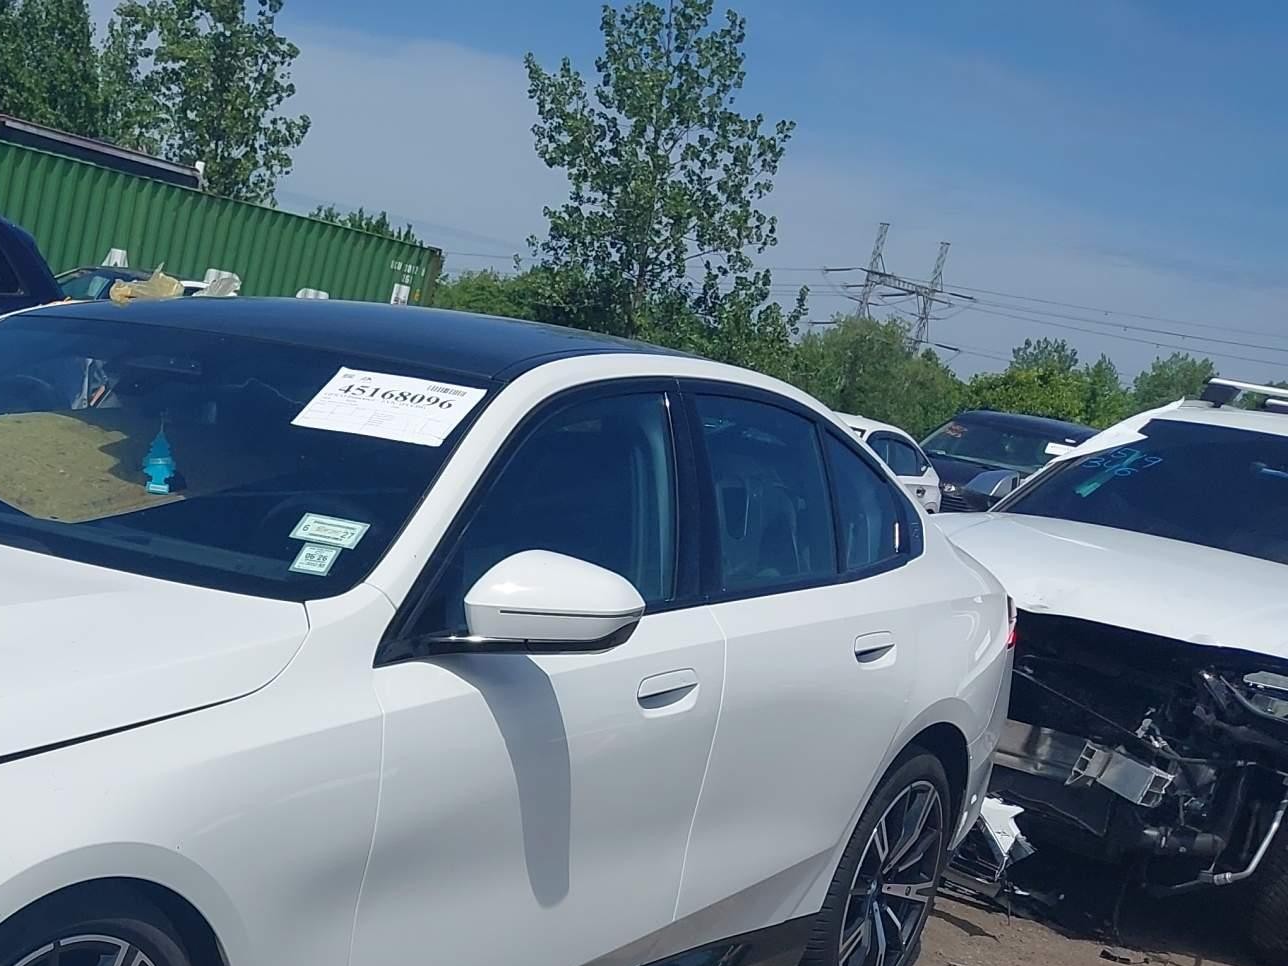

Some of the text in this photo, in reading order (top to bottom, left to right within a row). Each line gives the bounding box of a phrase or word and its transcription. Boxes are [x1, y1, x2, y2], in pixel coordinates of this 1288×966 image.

[338, 383, 454, 410] 45168096
[302, 524, 311, 532] 6
[340, 531, 356, 540] 27
